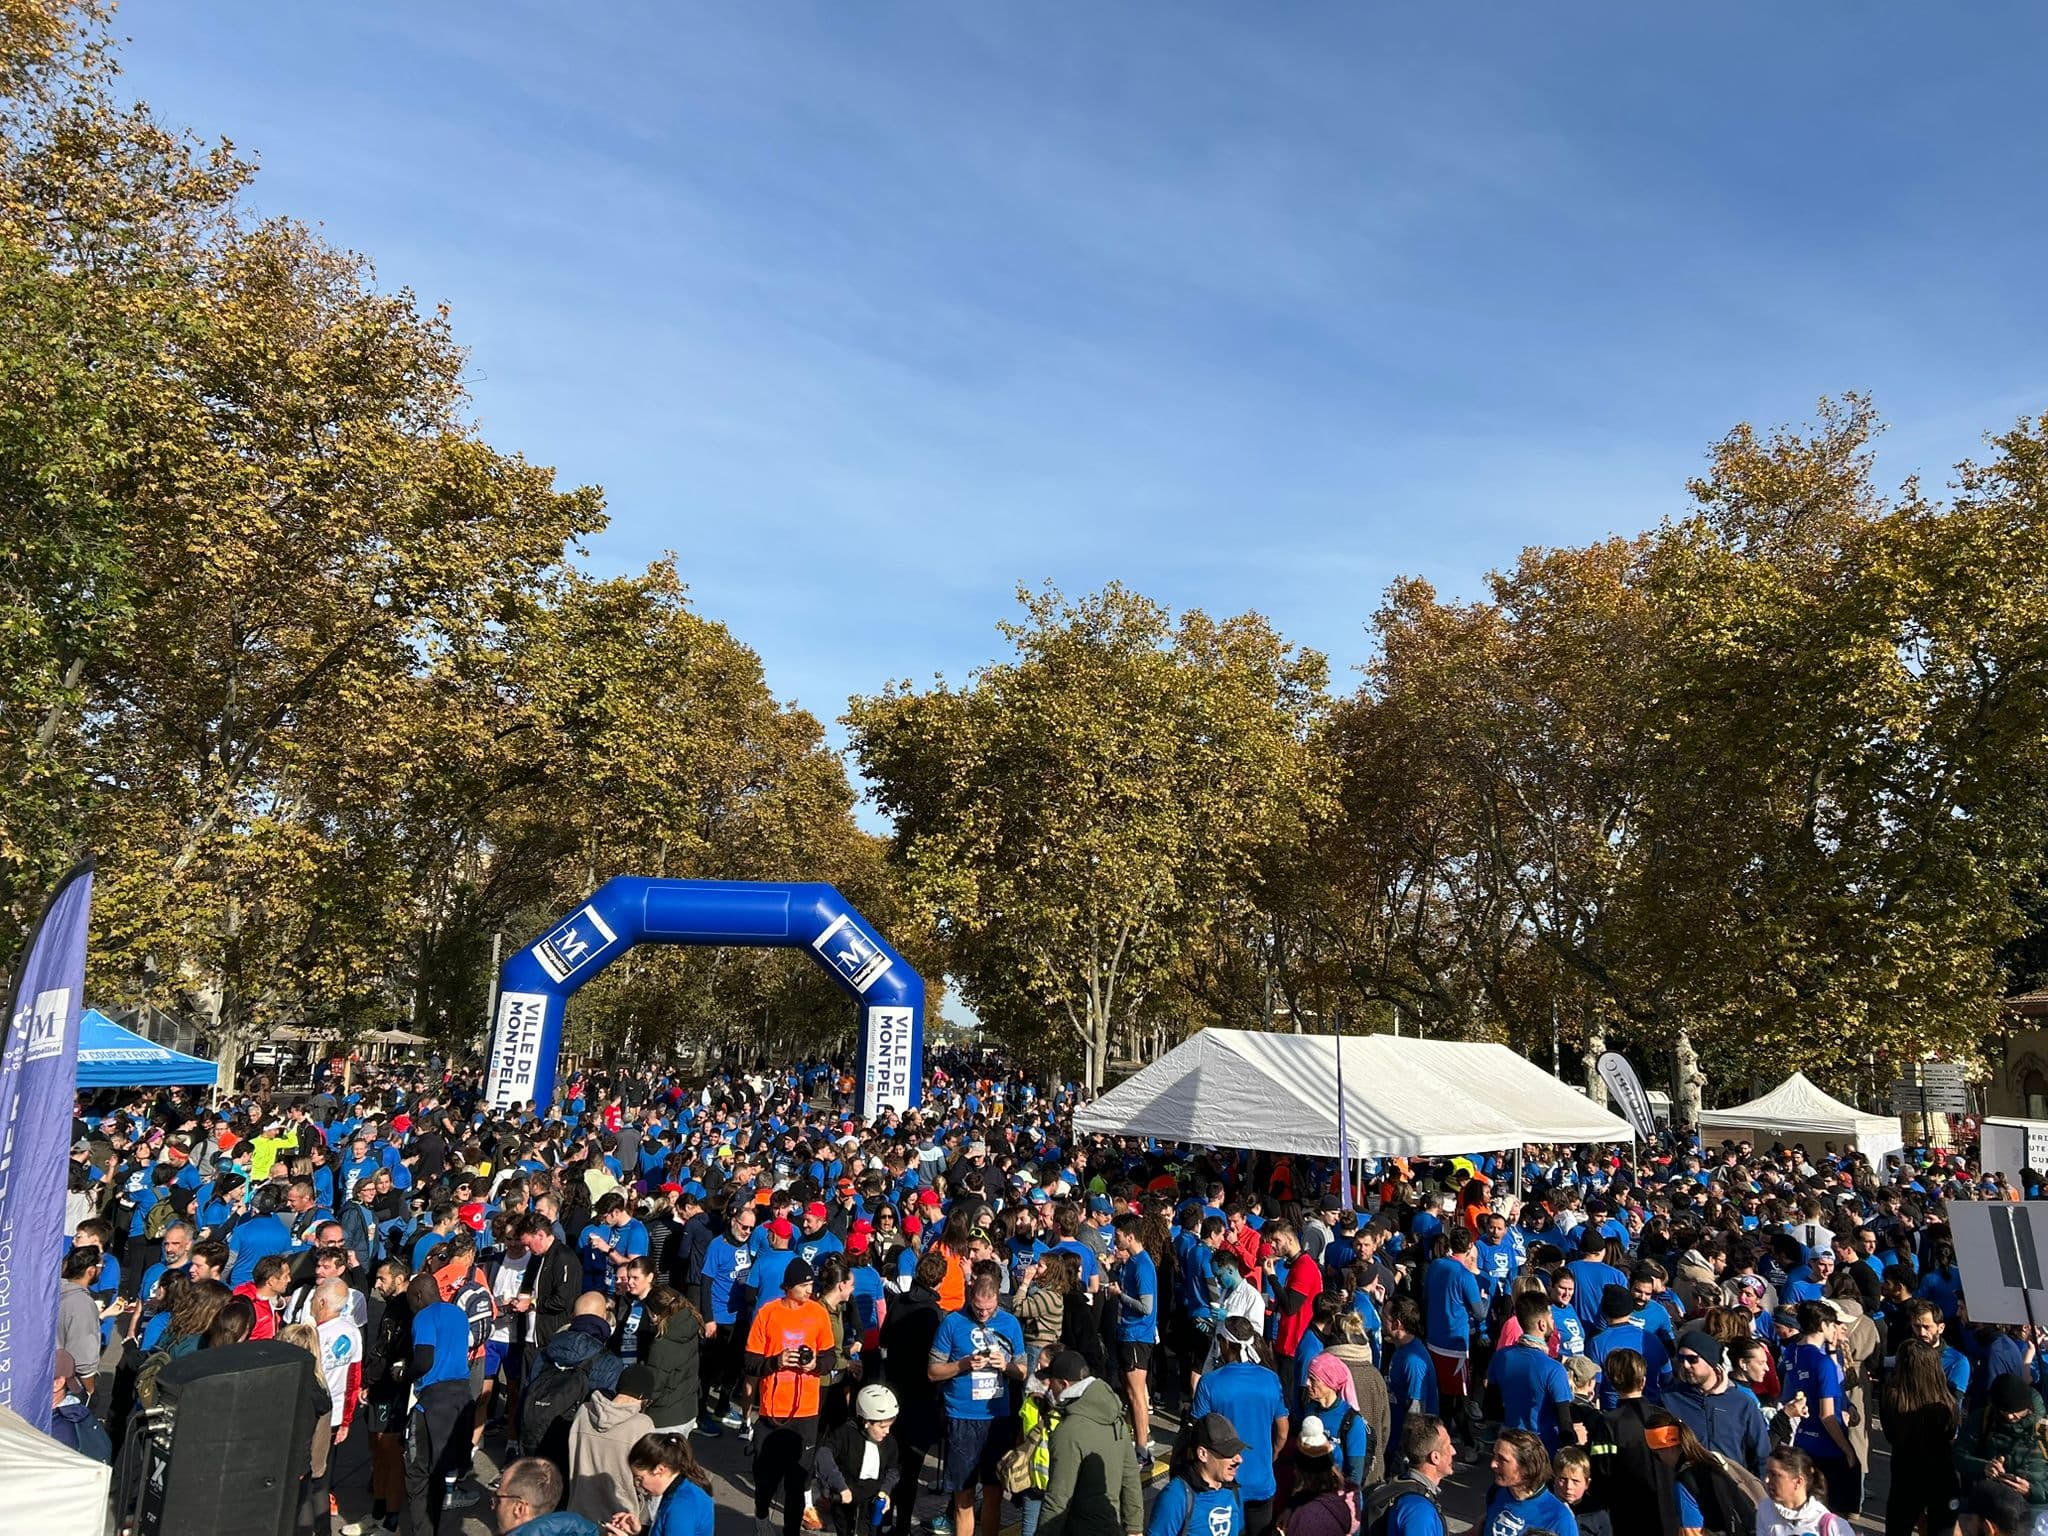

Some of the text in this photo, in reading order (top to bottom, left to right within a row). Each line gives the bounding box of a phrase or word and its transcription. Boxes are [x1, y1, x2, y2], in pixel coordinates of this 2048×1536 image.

[555, 928, 589, 962] M
[837, 939, 872, 972] M
[31, 1011, 56, 1042] M
[515, 1003, 540, 1084] VILLE DE
[495, 1002, 523, 1120] MONTPELLIE
[876, 1015, 893, 1114] MONTPELL
[893, 1016, 908, 1096] VILLE DE
[0, 1357, 10, 1372] &
